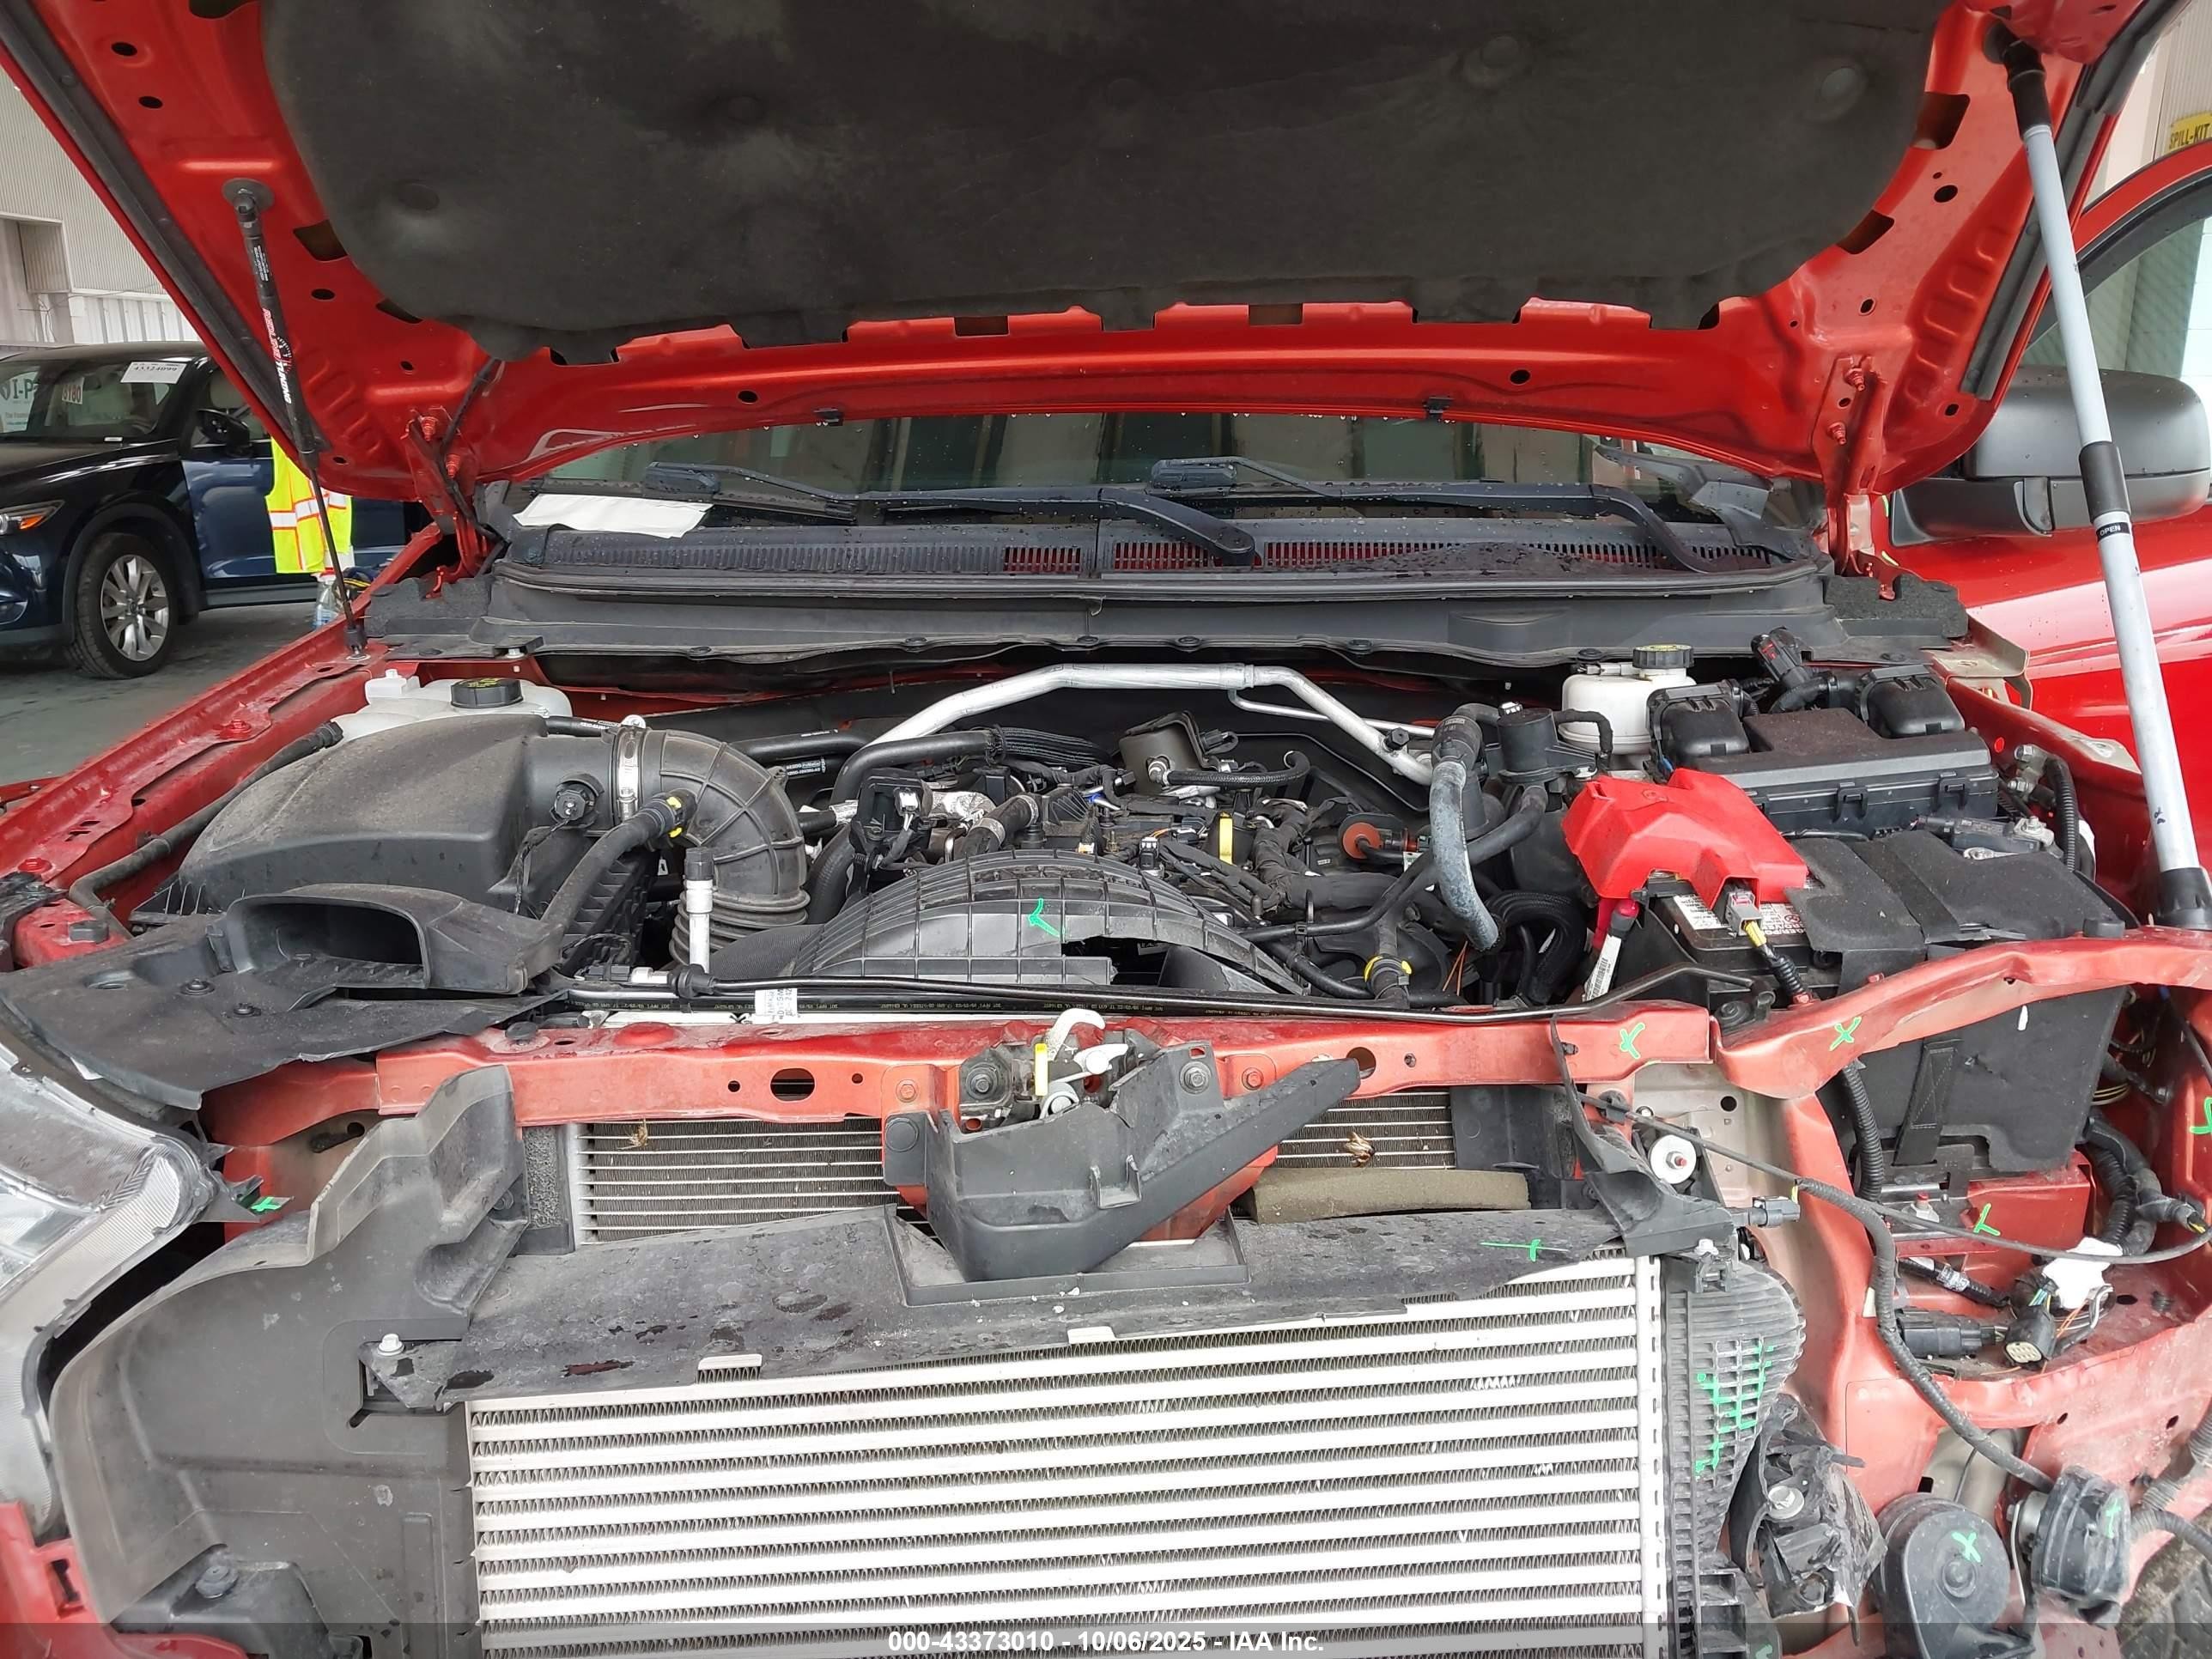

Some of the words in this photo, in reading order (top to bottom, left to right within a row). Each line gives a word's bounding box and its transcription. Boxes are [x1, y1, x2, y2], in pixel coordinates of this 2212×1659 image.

[2169, 123, 2210, 149] SPILL-KIT
[13, 378, 37, 399] I-P
[275, 361, 292, 404] TUNING
[2100, 525, 2121, 537] OPEN
